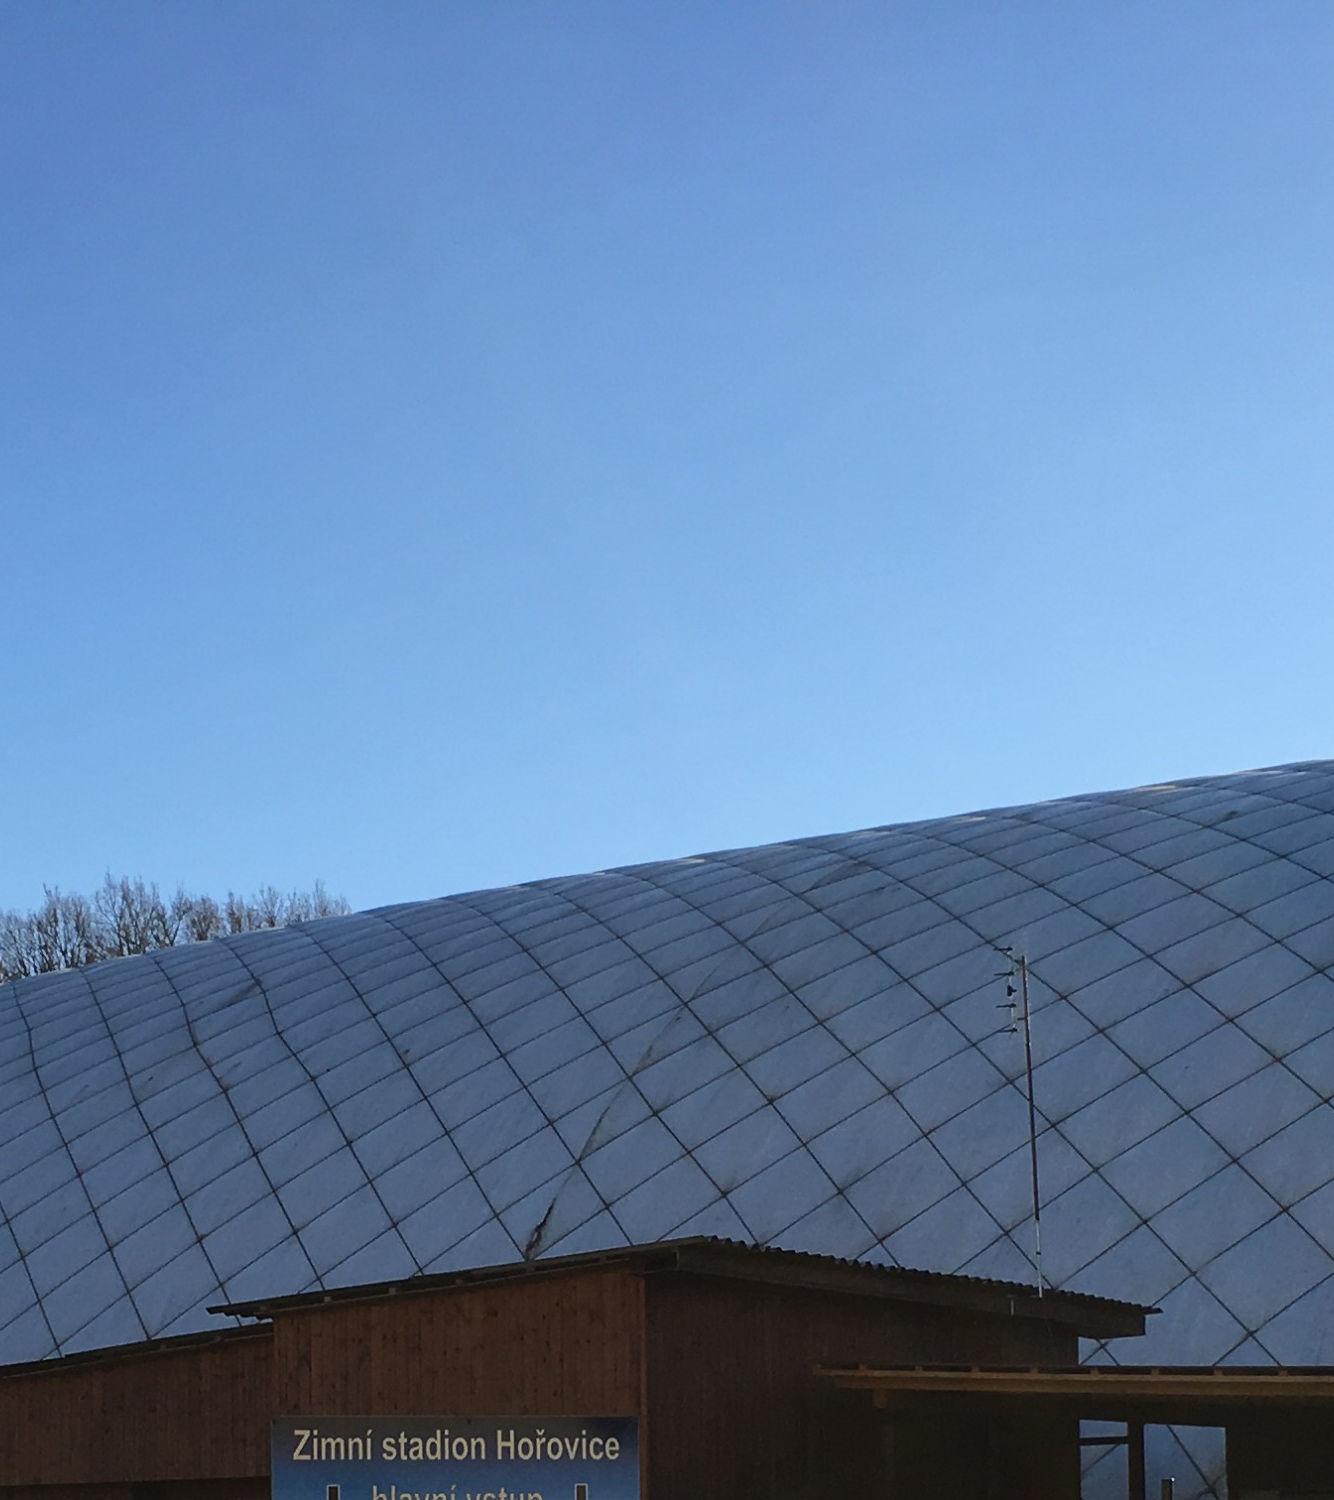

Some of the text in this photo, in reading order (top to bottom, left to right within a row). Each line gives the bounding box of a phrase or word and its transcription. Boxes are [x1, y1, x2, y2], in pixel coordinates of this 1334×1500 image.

[293, 1428, 620, 1461] Zimní stadion Hořovice
